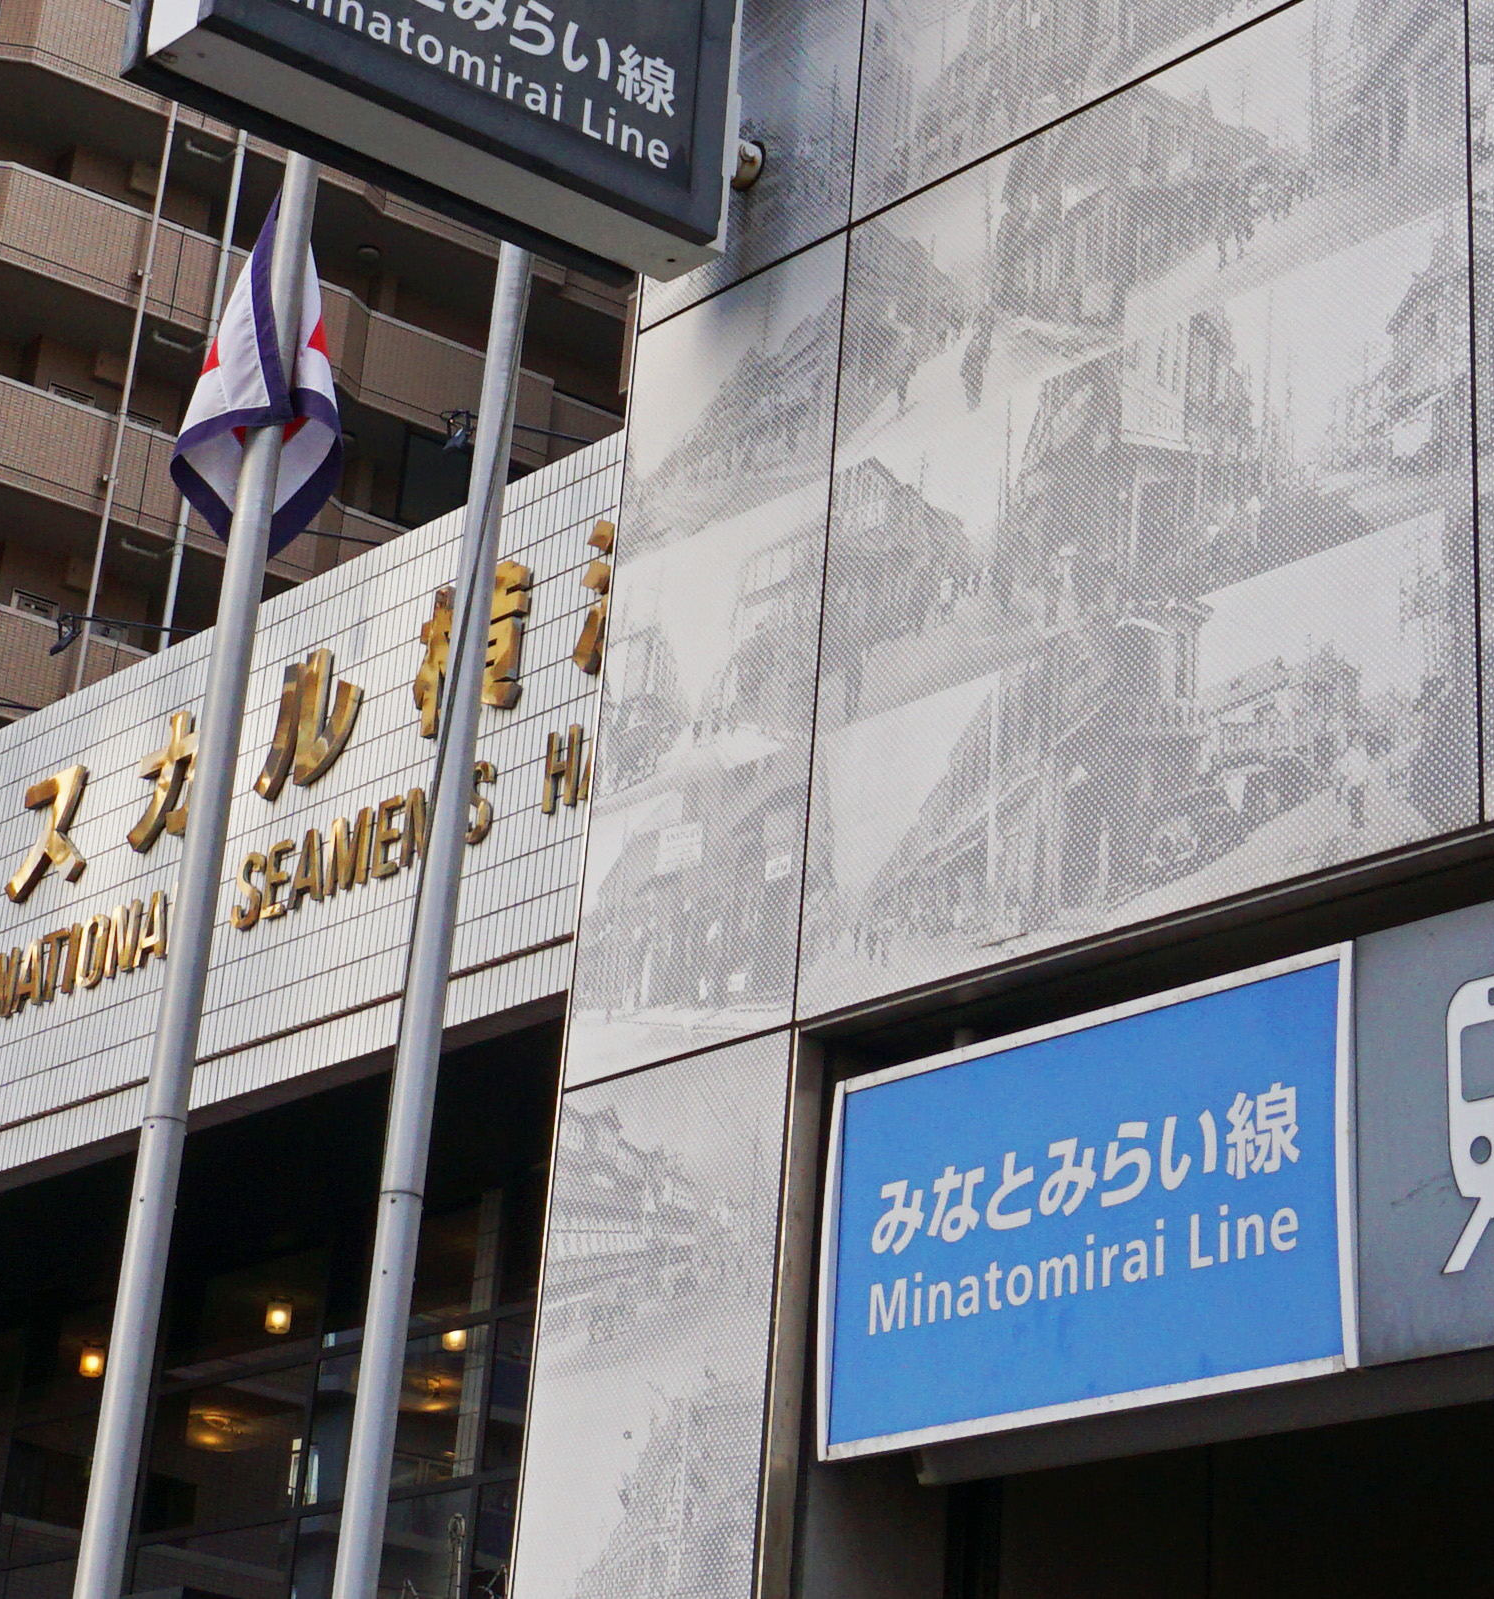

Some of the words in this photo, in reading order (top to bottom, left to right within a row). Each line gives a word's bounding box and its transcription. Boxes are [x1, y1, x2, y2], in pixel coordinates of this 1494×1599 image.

[581, 95, 671, 171] Line
[871, 1081, 1301, 1256] みなとみらい線
[868, 1218, 1165, 1336] Minatomirai
[1189, 1205, 1299, 1270] Line
